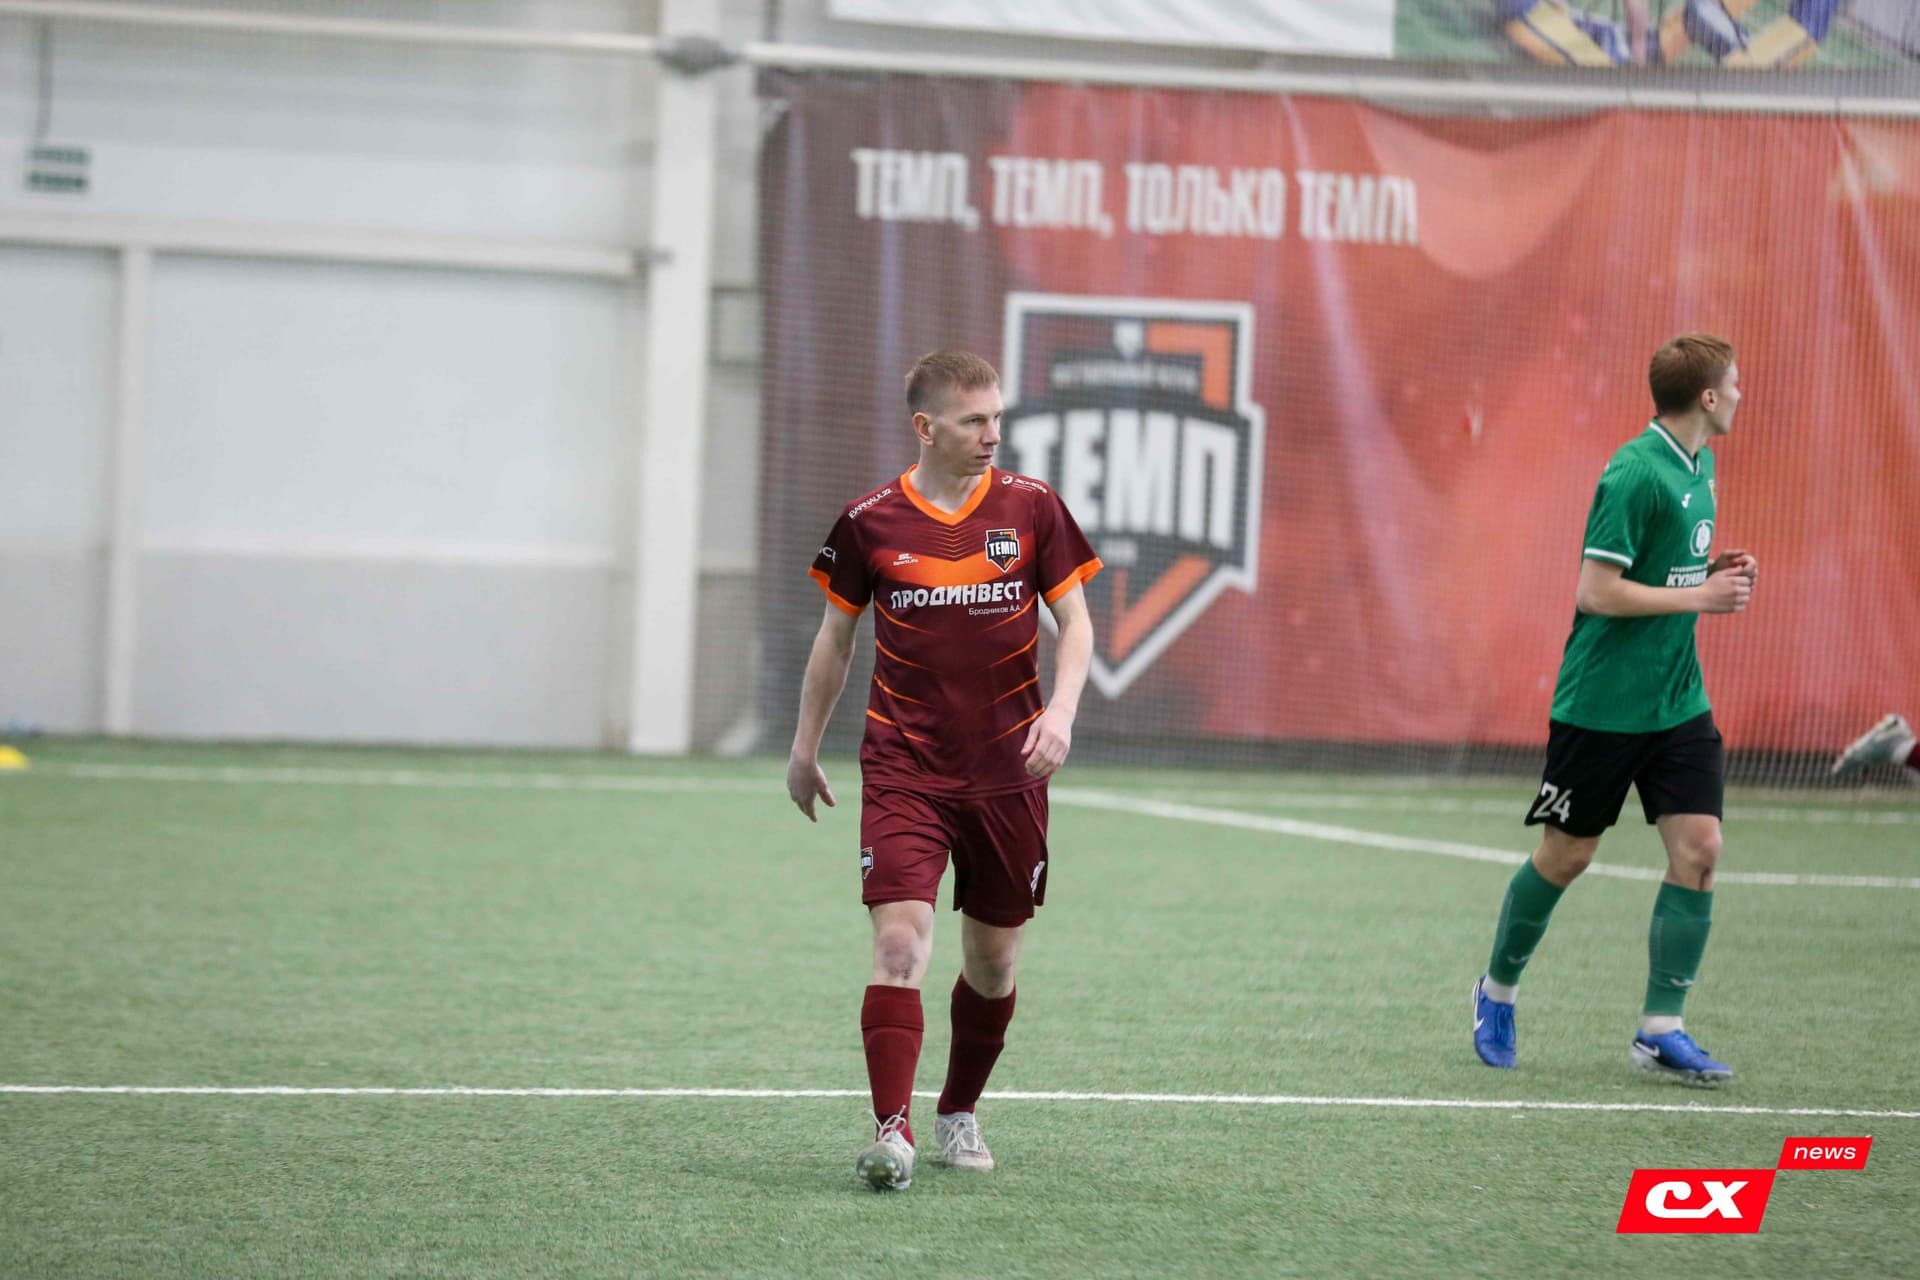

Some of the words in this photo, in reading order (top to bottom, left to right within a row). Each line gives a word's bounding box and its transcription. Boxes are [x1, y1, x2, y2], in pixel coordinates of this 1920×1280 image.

[851, 148, 980, 231] ТЕМП,
[988, 156, 1114, 238] ТЕМП,
[1124, 162, 1286, 240] ТОЛЬКО
[1009, 407, 1238, 550] ТЕМП
[988, 541, 1018, 557] ТЕМП
[890, 581, 1023, 610] ПРОДИНВЕСТ
[1532, 780, 1573, 824] 24
